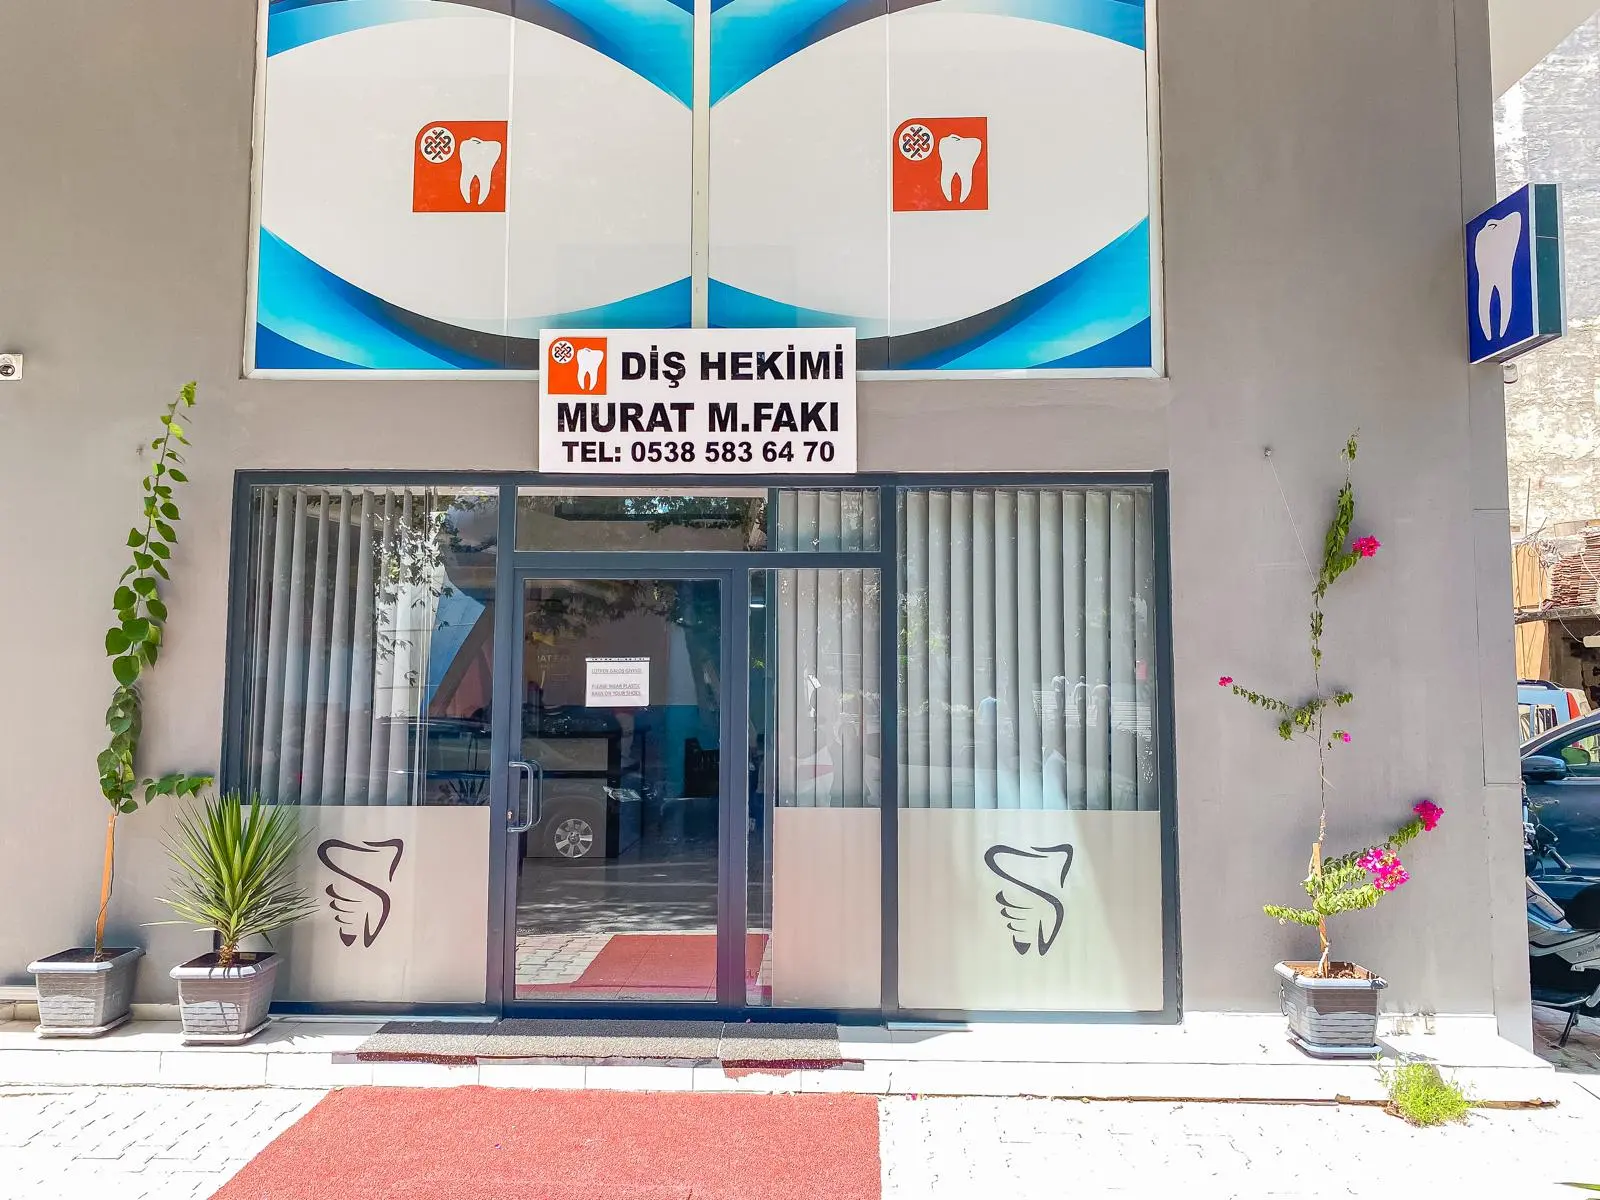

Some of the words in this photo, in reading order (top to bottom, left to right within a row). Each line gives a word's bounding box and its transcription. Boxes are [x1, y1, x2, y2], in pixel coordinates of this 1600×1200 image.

[621, 344, 686, 389] DİŞ
[700, 343, 844, 381] HEKİMİ
[557, 402, 695, 433] MURAT
[708, 401, 839, 433] M.FAKI
[561, 441, 621, 463] TEL:
[631, 441, 696, 463] 0538
[704, 441, 753, 463] 583
[762, 440, 795, 463] 64
[803, 440, 835, 463] 70
